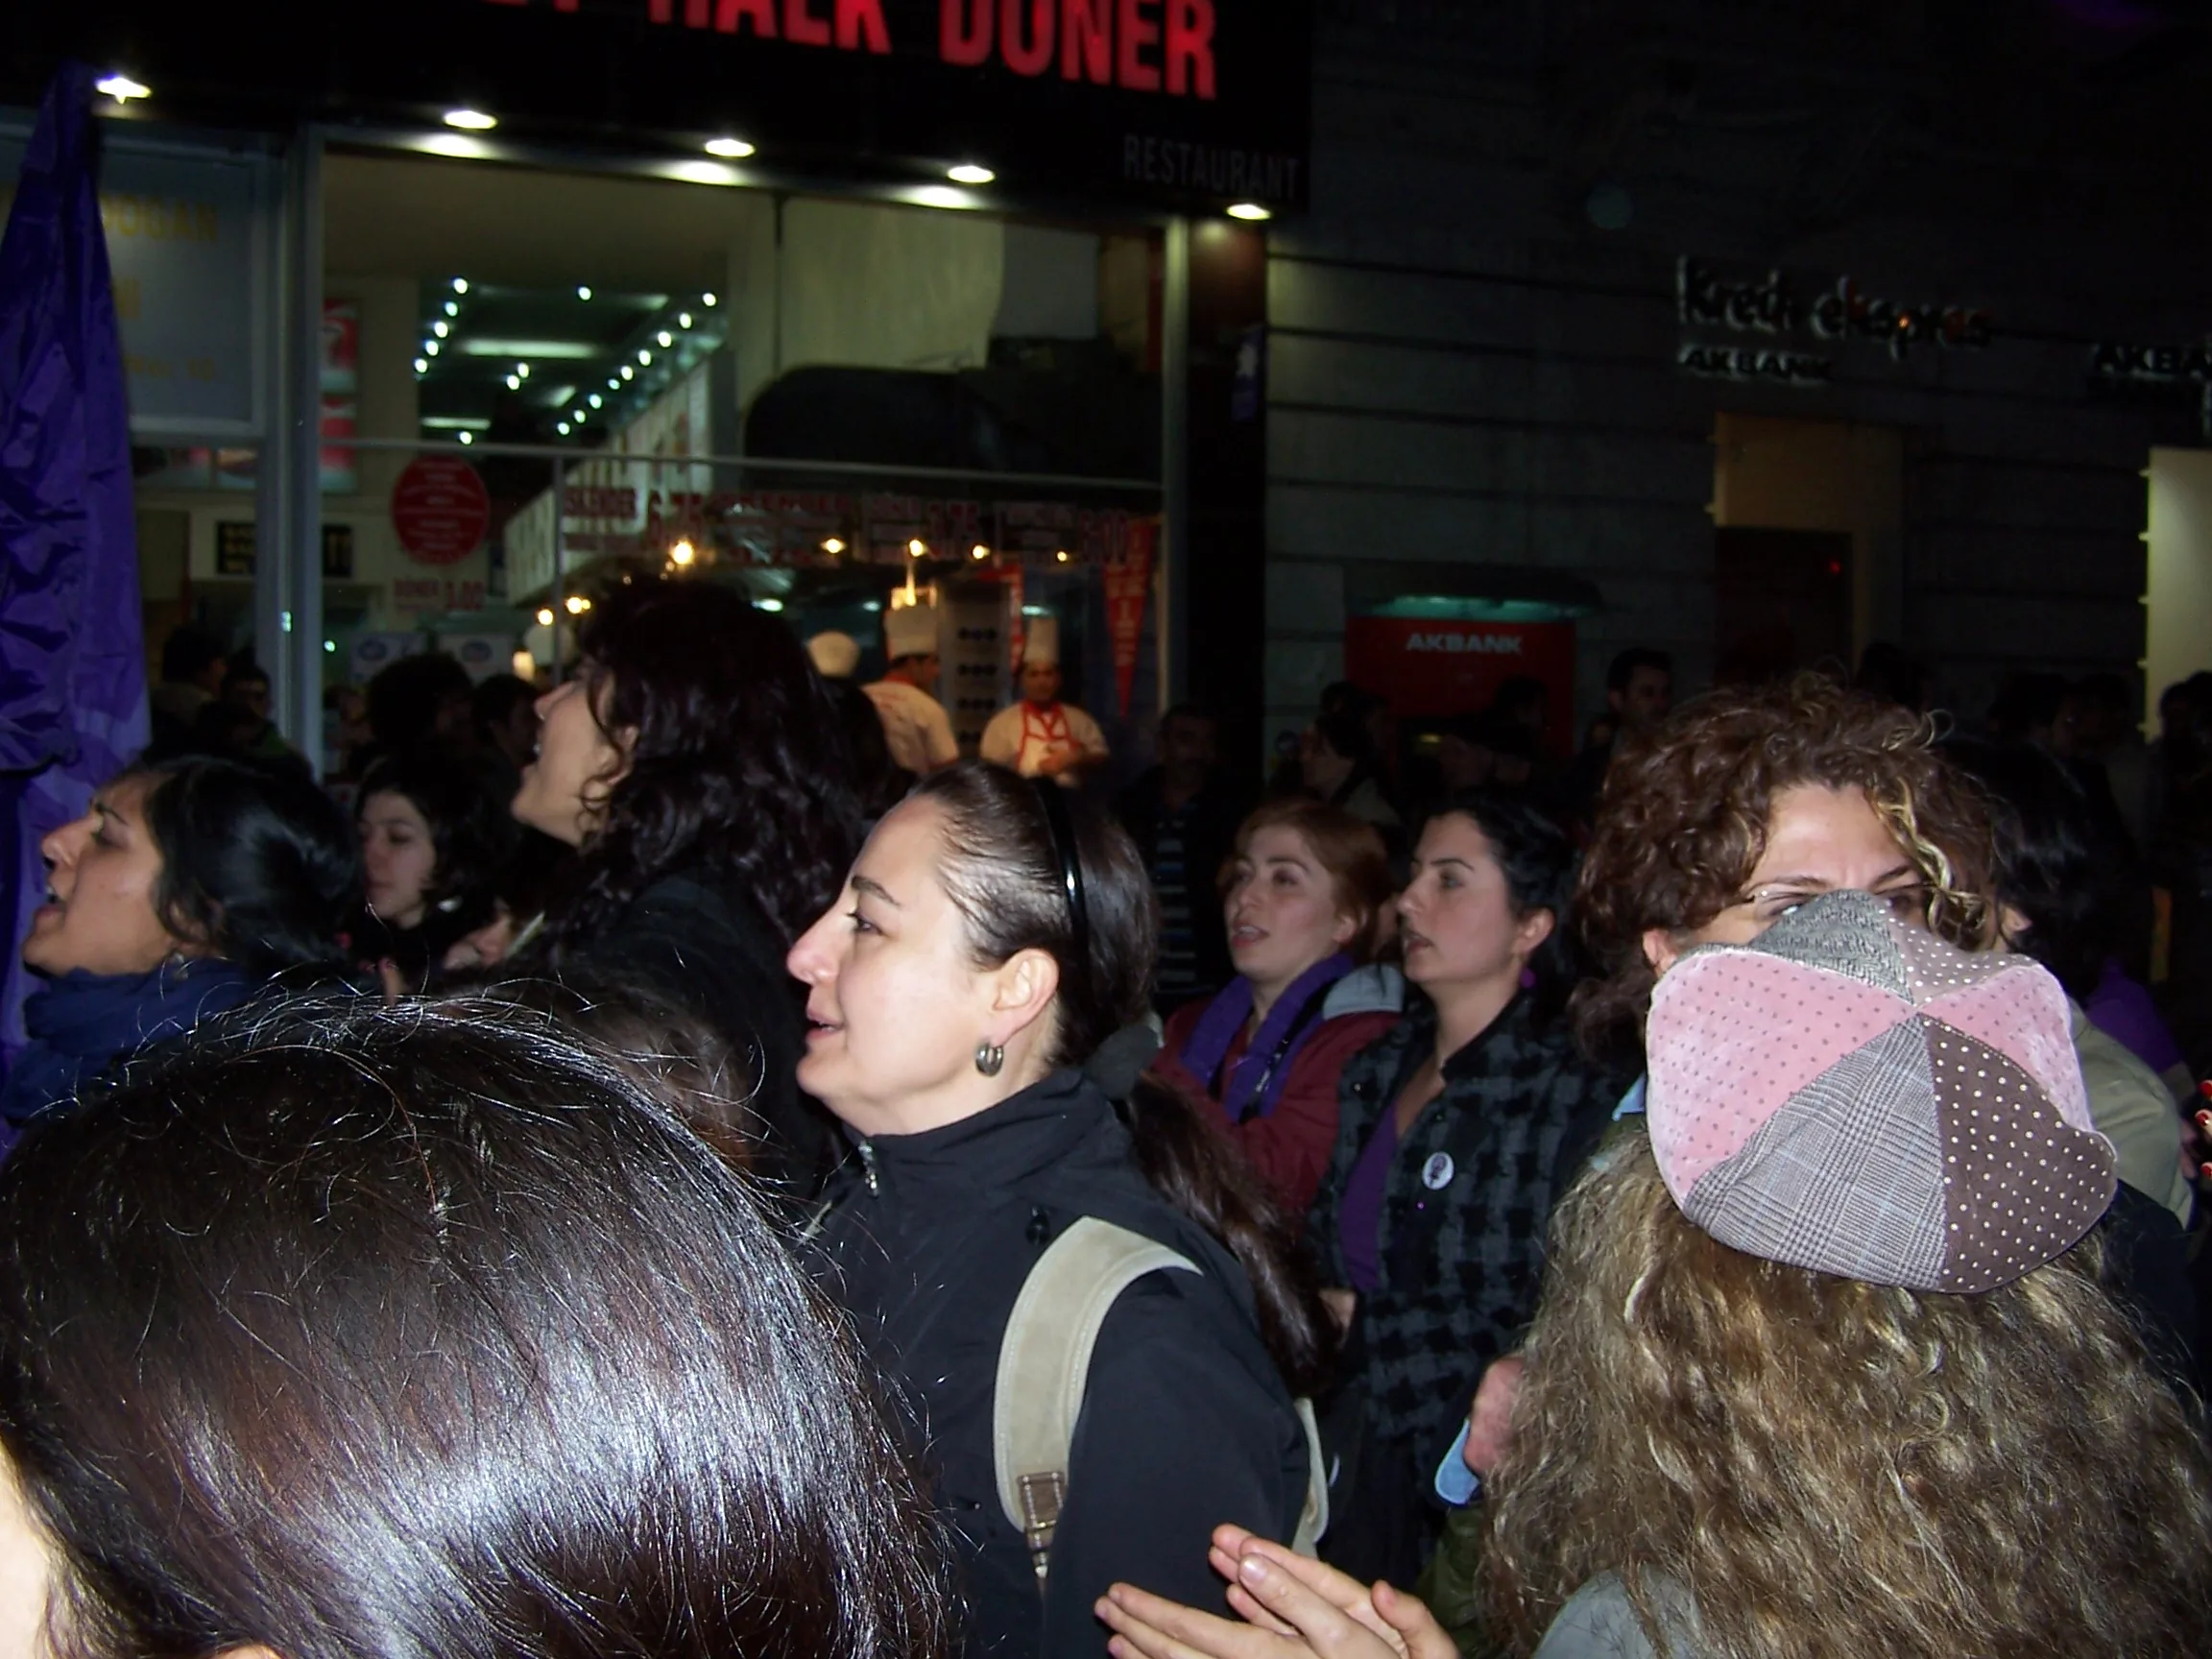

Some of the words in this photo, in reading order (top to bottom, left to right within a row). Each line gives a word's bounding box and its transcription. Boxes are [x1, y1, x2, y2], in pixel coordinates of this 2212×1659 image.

[1122, 132, 1302, 202] RESTAURANT
[1677, 342, 1832, 382] AKBANK
[1406, 632, 1524, 655] AKBANK
